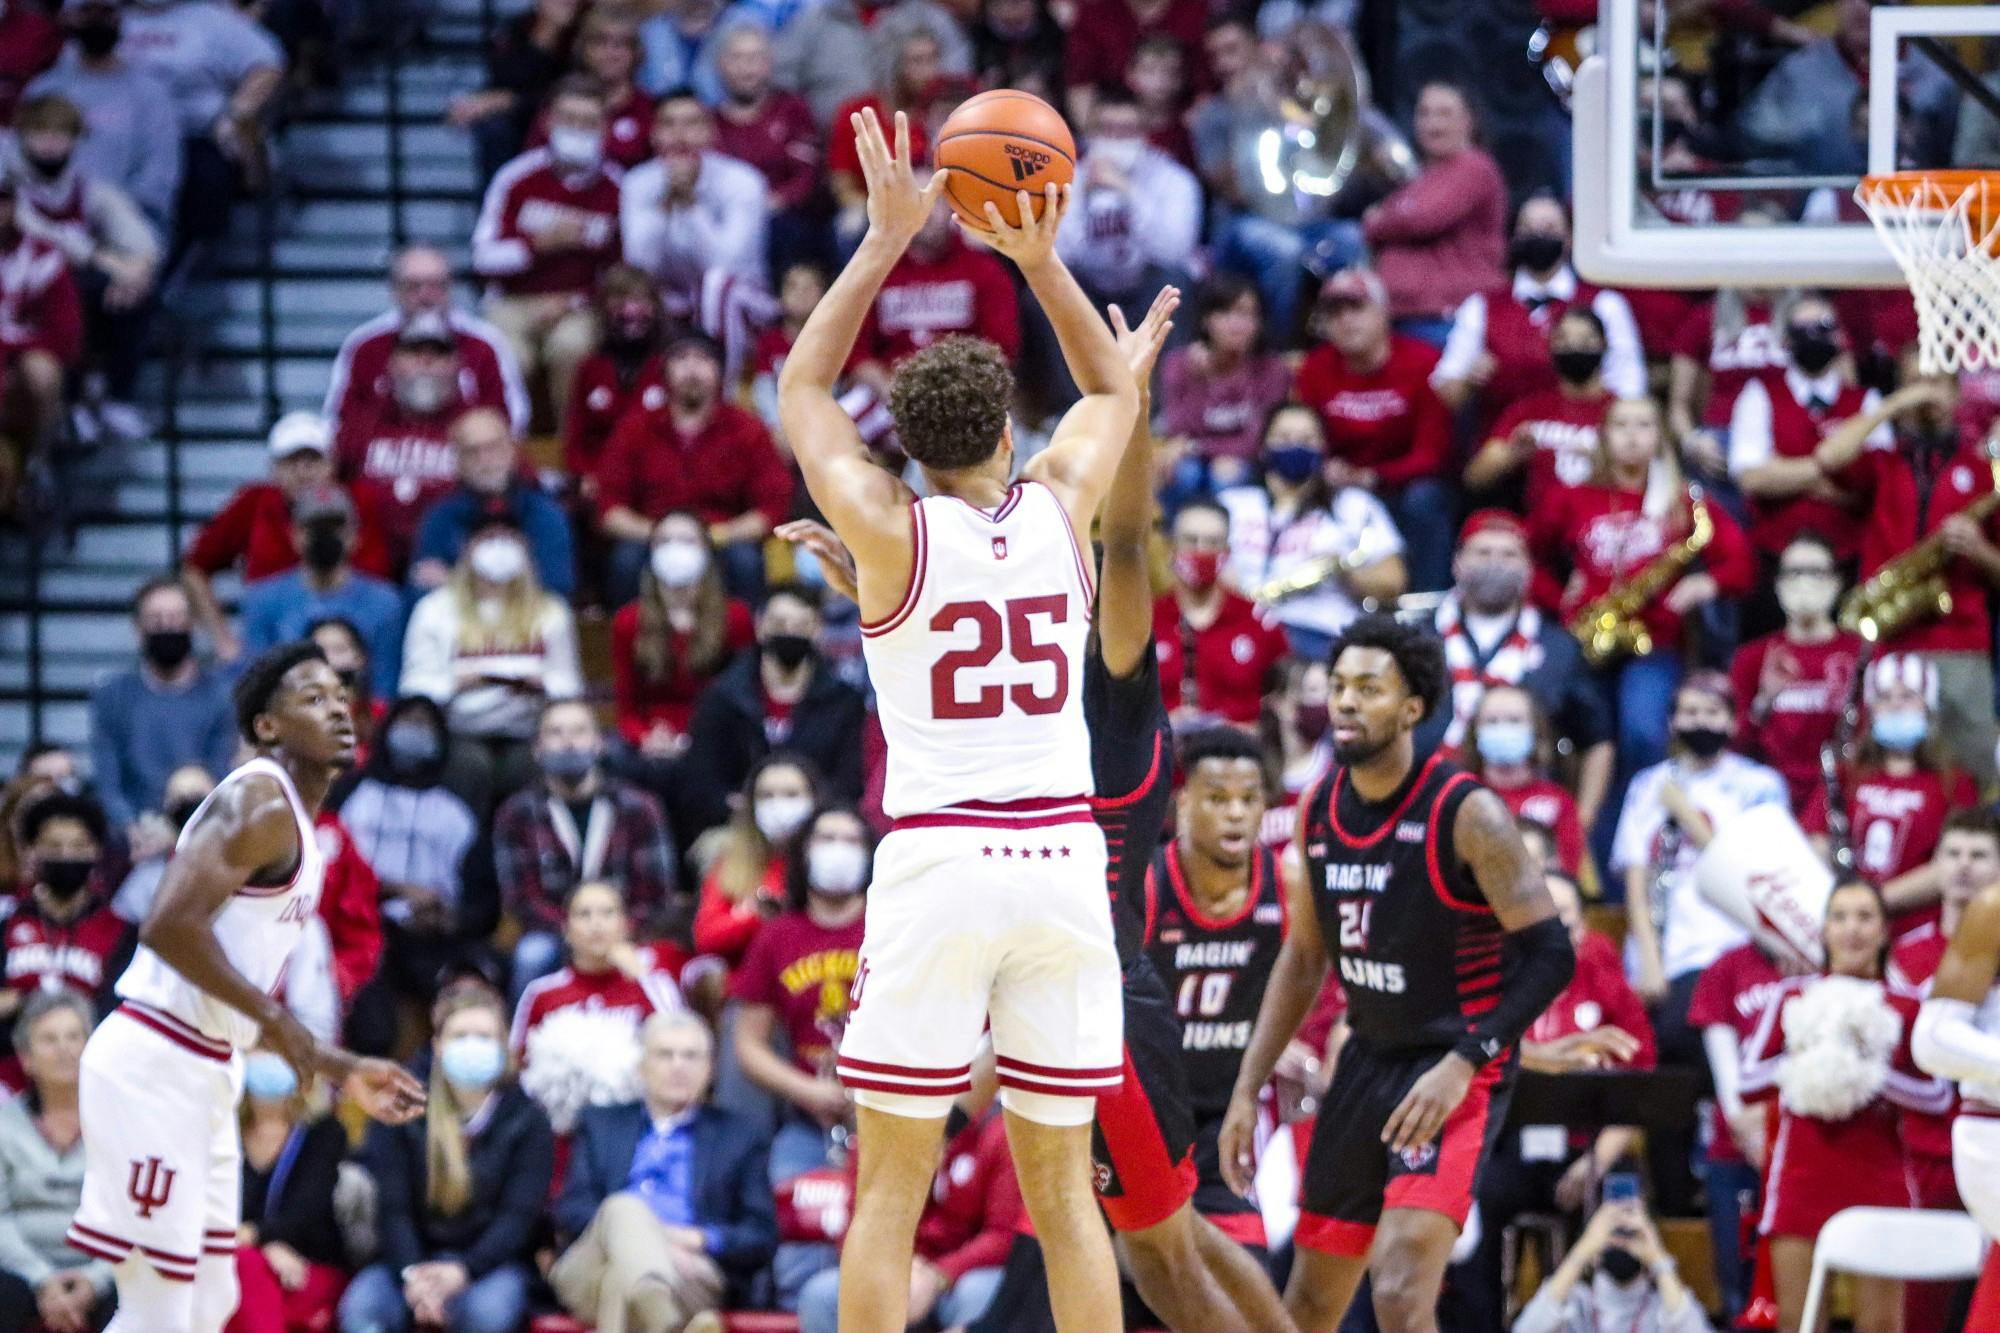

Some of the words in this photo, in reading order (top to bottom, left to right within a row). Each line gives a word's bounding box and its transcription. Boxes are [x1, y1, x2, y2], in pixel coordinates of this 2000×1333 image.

[1004, 143, 1050, 164] adidas
[930, 593, 1069, 720] 25
[1176, 971, 1237, 1017] 10
